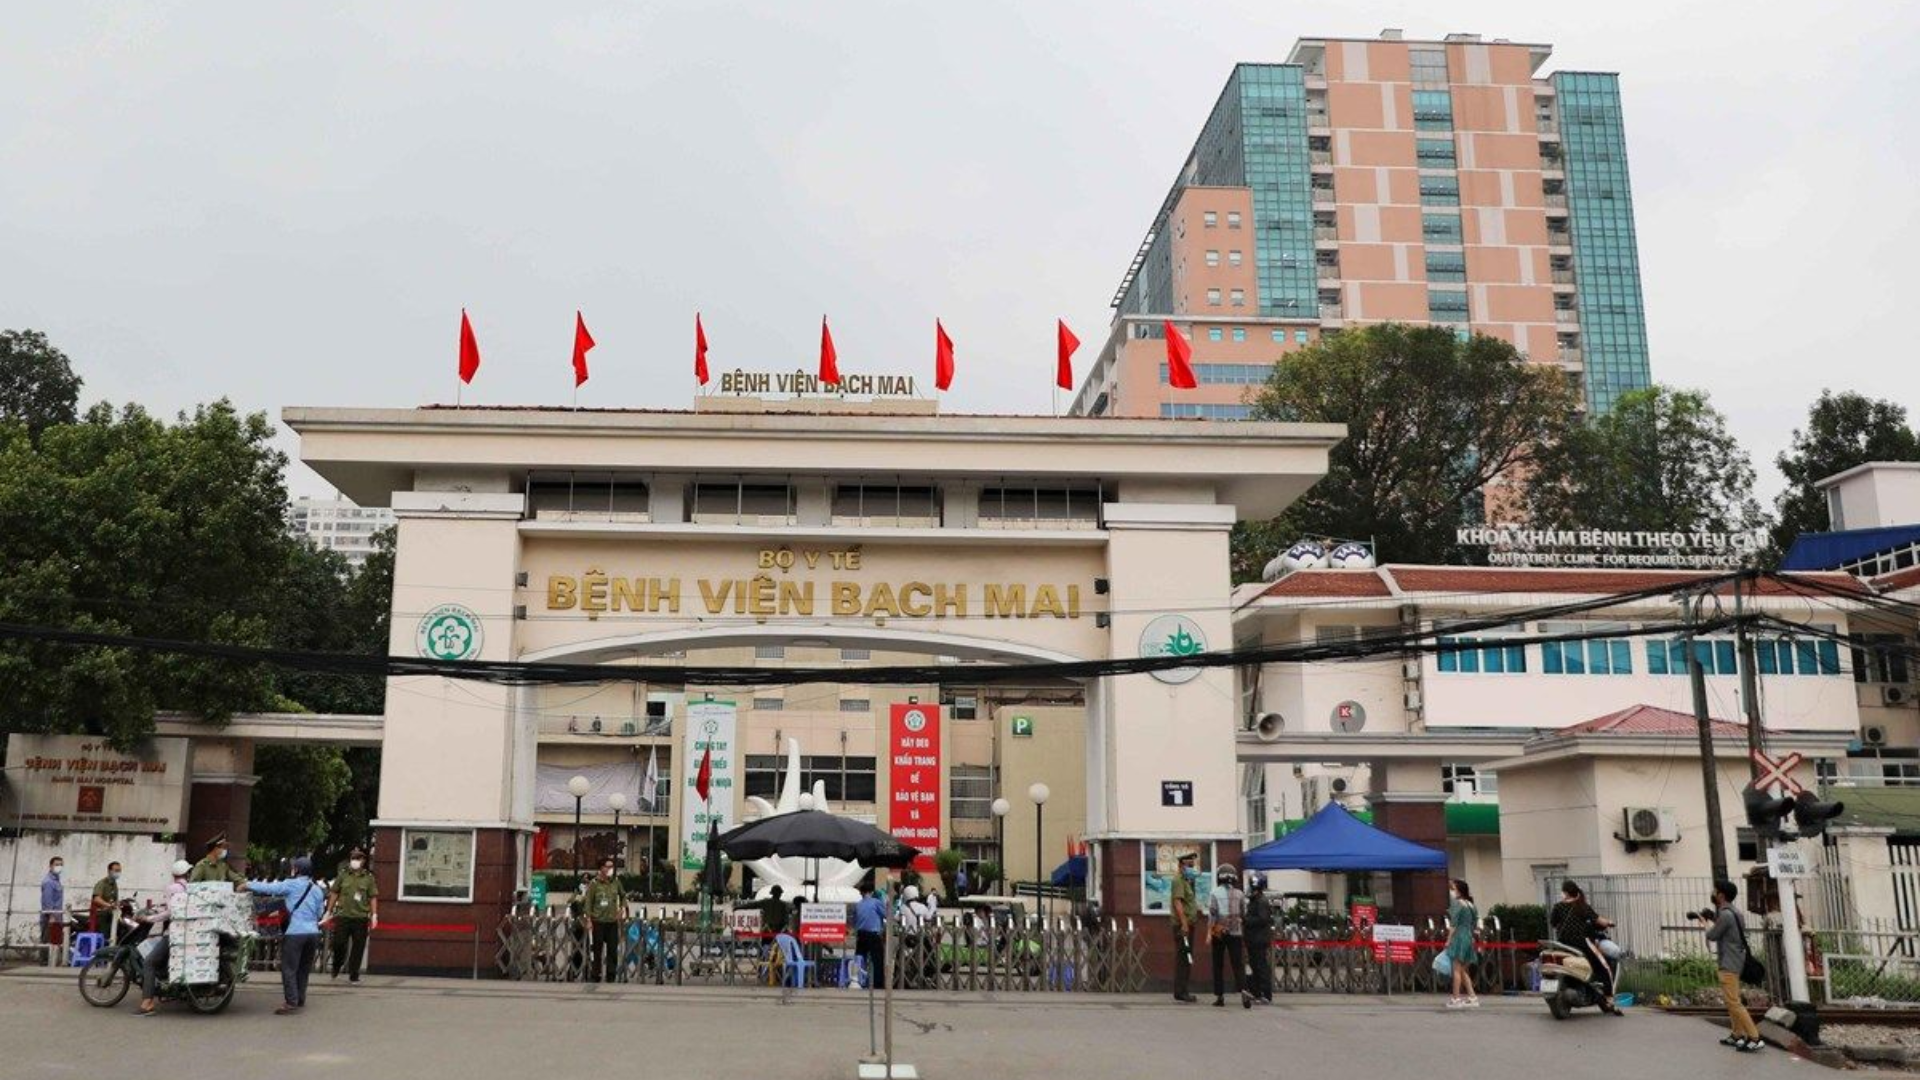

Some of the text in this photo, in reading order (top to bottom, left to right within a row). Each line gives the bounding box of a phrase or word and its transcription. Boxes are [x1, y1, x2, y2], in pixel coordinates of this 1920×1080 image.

[721, 368, 770, 397] BỆNH
[776, 369, 818, 398] VIỆN
[877, 375, 914, 395] MAI
[1457, 529, 1512, 546] KHOA
[1517, 524, 1577, 547] KHÁM
[1579, 528, 1632, 550] BỆNH
[1634, 531, 1686, 548] THEO
[758, 544, 863, 574] BỘ Y TẾ
[1488, 552, 1560, 564] OUTPATIENT
[1564, 553, 1601, 565] CLINIC
[1603, 554, 1626, 565] FOR
[1628, 554, 1686, 566] REQUIRED
[547, 569, 1080, 627] BỆNH VIỆN BẠCH MAI
[1017, 718, 1027, 734] P
[1169, 790, 1183, 804] 1
